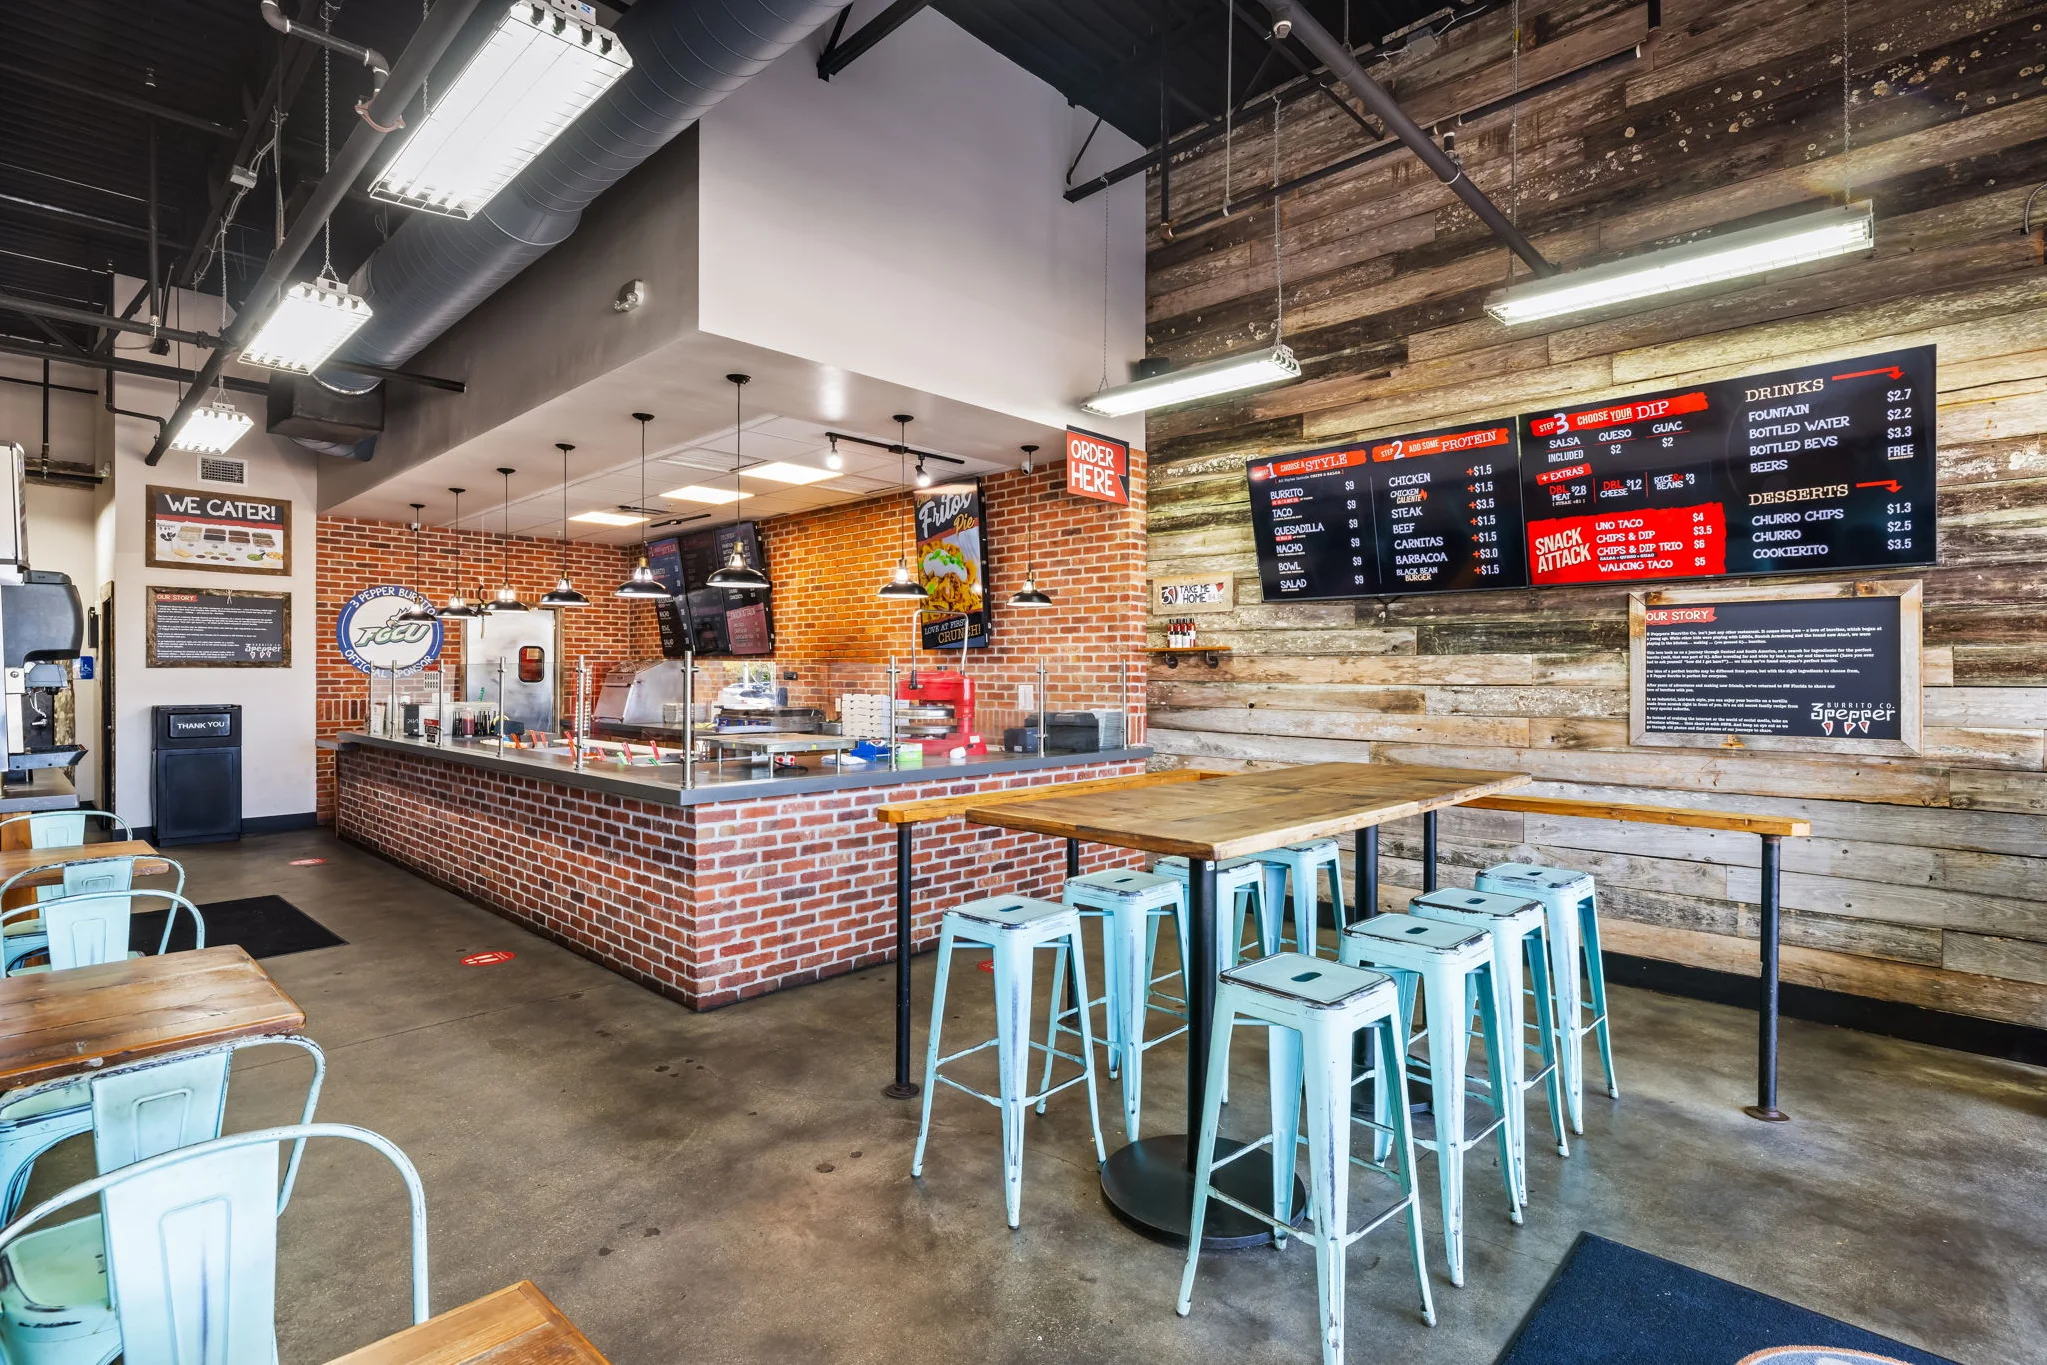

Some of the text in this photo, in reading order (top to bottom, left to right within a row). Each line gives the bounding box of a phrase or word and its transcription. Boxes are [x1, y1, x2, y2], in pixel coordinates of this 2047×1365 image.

[1745, 379, 1824, 402] DRINKS
[1749, 389, 1912, 421] FOUNTAIN $2.7
[1539, 401, 1669, 435] STEP 3 CHOOSE YOUR DIP
[1750, 408, 1912, 438] BOTTLED WATER $2.2
[1653, 421, 1682, 433] GUAC
[1550, 437, 1580, 449] SALSA
[1598, 429, 1632, 442] QUESO
[1662, 438, 1673, 448] $2
[1750, 426, 1912, 456] BOTTLED BEVS $3.3
[1070, 439, 1114, 468] ORDER
[1381, 431, 1496, 460] STEP 2 ADD SOME PROTEIN
[1611, 444, 1621, 455] $2
[1548, 450, 1584, 463] INCLUDED
[1750, 444, 1914, 473] BEERS FREE
[1267, 463, 1277, 478] 1
[1280, 462, 1300, 472] CHOOSE
[1306, 454, 1347, 472] STYLE
[1550, 467, 1584, 481] EXTRAS
[1071, 461, 1116, 497] HERE
[1389, 473, 1430, 487] CHICKEN
[1603, 481, 1625, 490] DBL
[1654, 475, 1673, 484] RICE
[1686, 474, 1695, 484] $3
[1657, 481, 1683, 490] BEANS
[1270, 481, 1354, 500] BURRITO $9
[1390, 488, 1419, 498] CHICKEN
[1550, 485, 1568, 495] DBL
[1552, 493, 1570, 501] MEAT
[1600, 490, 1628, 498] CHEESE
[1749, 484, 1849, 505] DESSERTS
[165, 494, 276, 520] WE CATER!
[1397, 495, 1421, 504] CALIENTE
[919, 492, 973, 538] Fritos
[1272, 508, 1292, 518] TACO
[1347, 500, 1356, 510] $9
[1392, 507, 1423, 519] STEAK
[1752, 502, 1911, 526] CHURRO CHIPS $1.3
[954, 514, 975, 536] Pie
[1274, 519, 1358, 536] QUESADILLA $9
[1393, 523, 1415, 534] BEEF
[1596, 513, 1704, 531] UNO TACO $4
[1596, 533, 1624, 543] CHIPS
[1639, 531, 1655, 540] DIP
[1694, 526, 1712, 535] $3.5
[1753, 521, 1911, 542] CHURRO $2.5
[1276, 538, 1360, 554] NACHO $9
[1395, 537, 1443, 549] CARNITAS
[1535, 528, 1582, 555] SNACK
[1597, 546, 1625, 556] CHIPS
[1639, 544, 1656, 553] DIP
[1659, 542, 1683, 551] TRIO
[1694, 540, 1705, 549] $6
[1753, 539, 1911, 559] COOKIERITO $3.5
[1278, 557, 1362, 571] BOWL $9
[1396, 553, 1448, 565] BARBACOA
[1538, 543, 1591, 573] ATTACK
[1598, 557, 1705, 572] WALKING TACO $5
[1180, 584, 1210, 593] TAKE ME
[1280, 576, 1364, 589] SALAD $9
[358, 587, 395, 602] PEPPER
[1183, 593, 1206, 603] HOME
[1646, 610, 1709, 622] OUR STORY
[354, 623, 430, 647] FGCU
[924, 619, 966, 635] LOVE AT FIRST
[345, 650, 388, 678] OFFICAL
[394, 656, 434, 678] SPONSOR
[1811, 703, 1824, 720] 3
[1824, 709, 1896, 726] pepper
